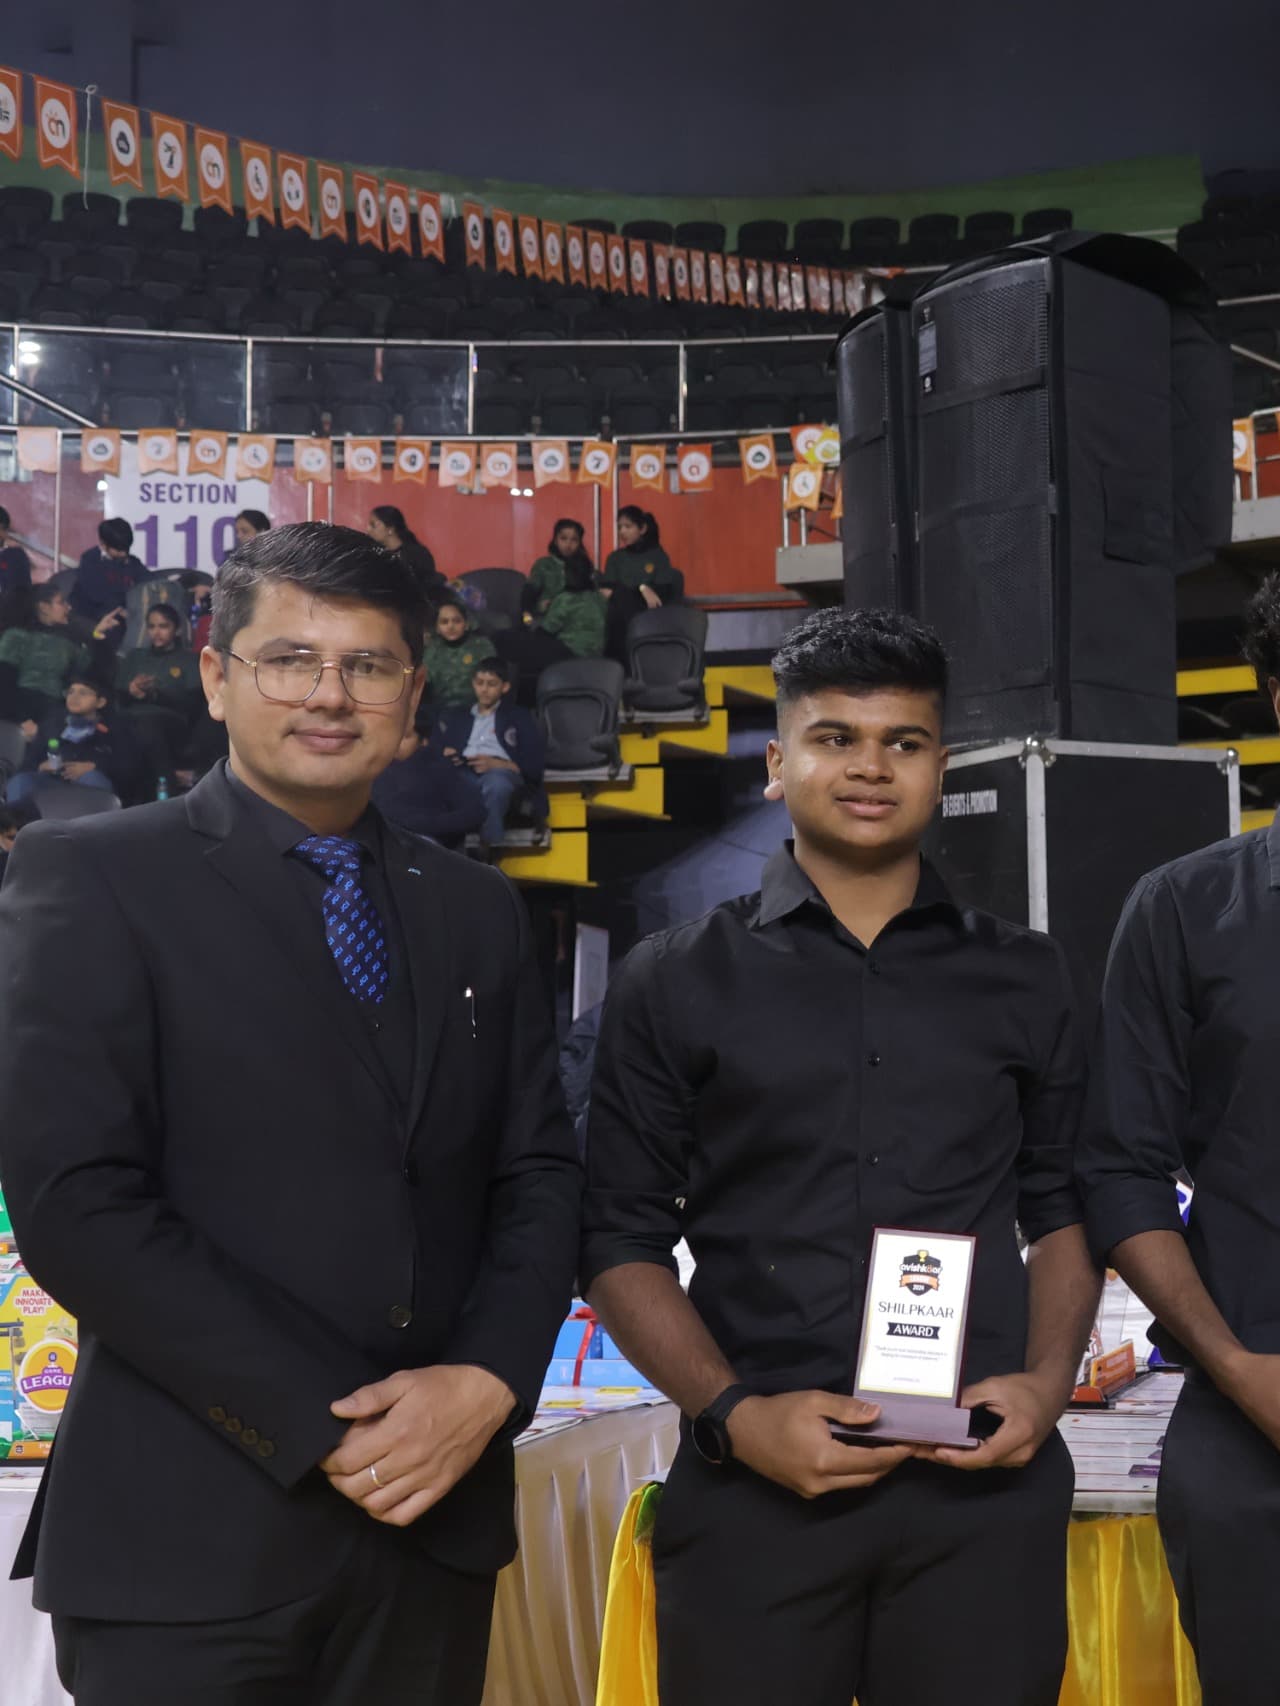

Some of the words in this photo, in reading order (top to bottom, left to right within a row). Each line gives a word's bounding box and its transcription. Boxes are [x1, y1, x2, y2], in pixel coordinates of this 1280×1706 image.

[139, 482, 237, 504] SECTION
[15, 1297, 52, 1306] INNOVATE
[23, 1306, 45, 1314] PLAY!
[878, 1301, 954, 1319] SHILPKAAR
[893, 1324, 934, 1337] AWARD
[22, 1375, 73, 1390] LEAGU
